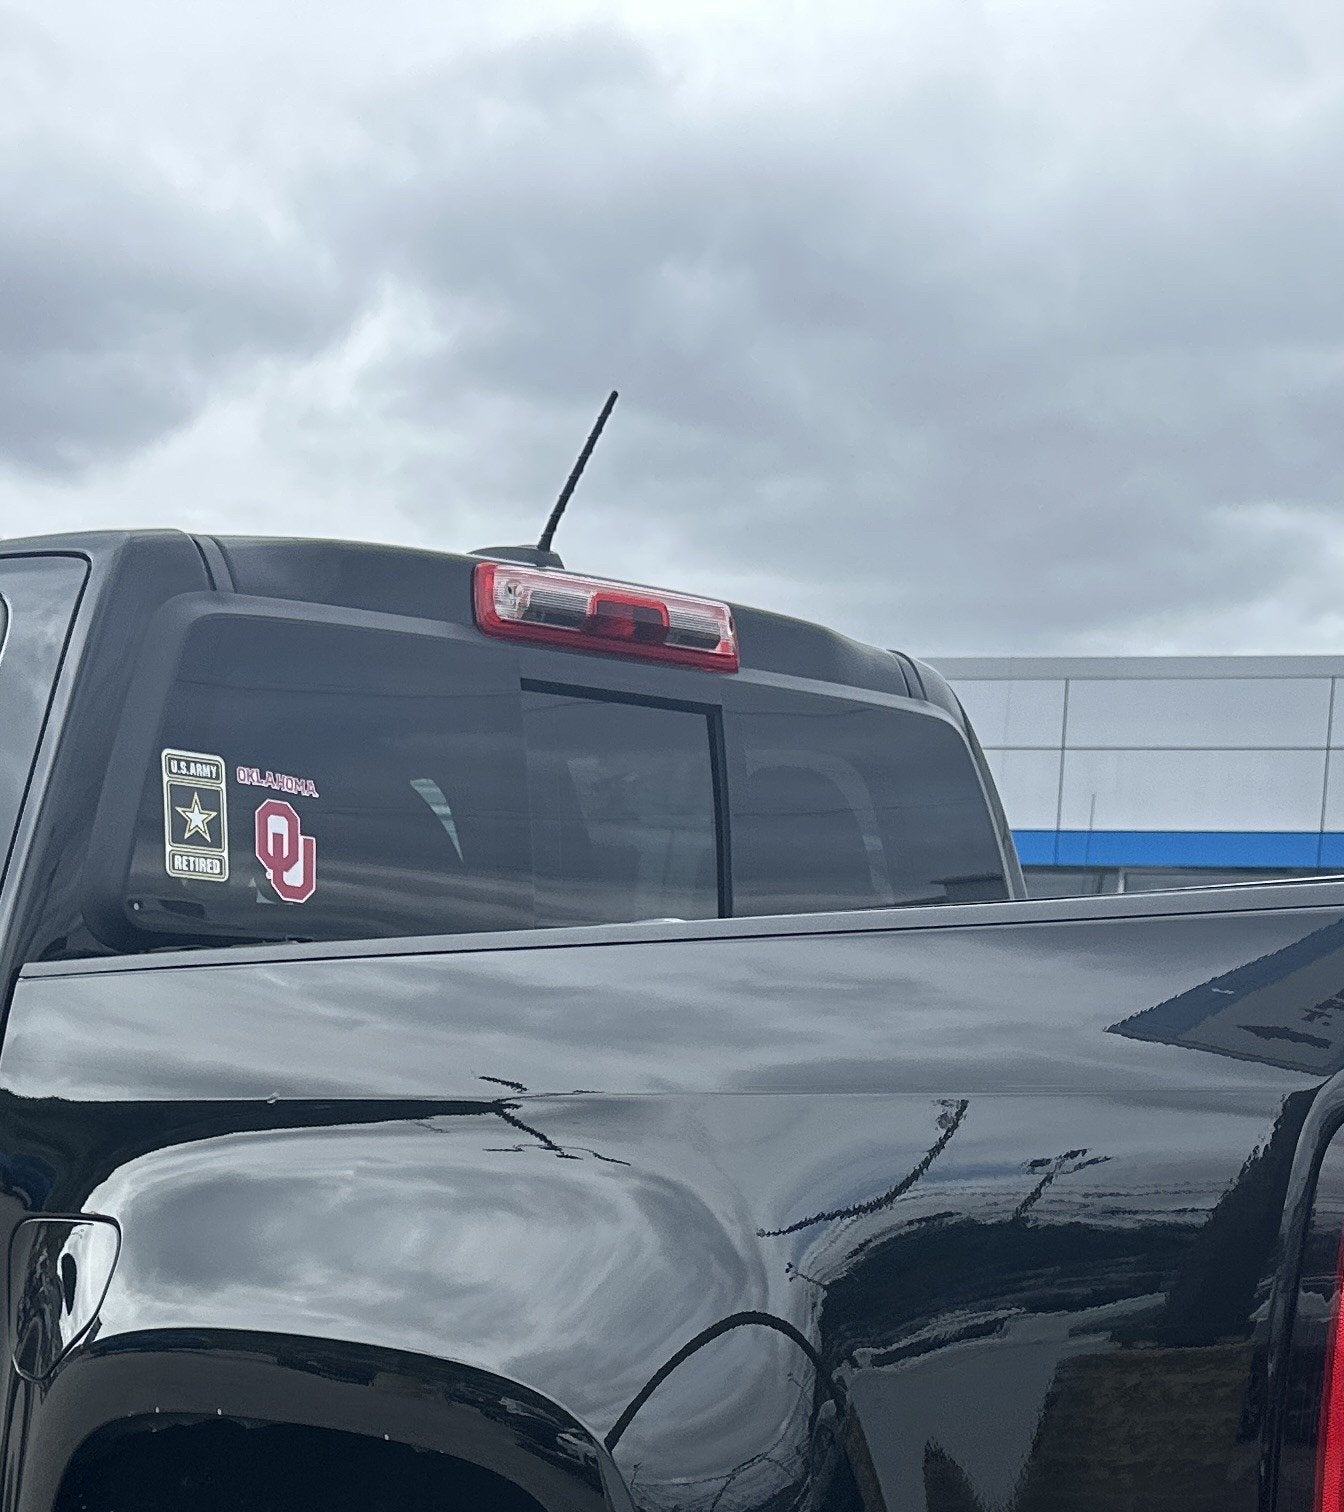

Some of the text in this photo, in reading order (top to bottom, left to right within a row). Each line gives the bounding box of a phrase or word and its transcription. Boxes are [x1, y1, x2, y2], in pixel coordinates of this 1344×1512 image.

[236, 766, 320, 798] OKLAHOMA
[174, 855, 221, 875] RETIRED
[254, 798, 317, 904] OU
